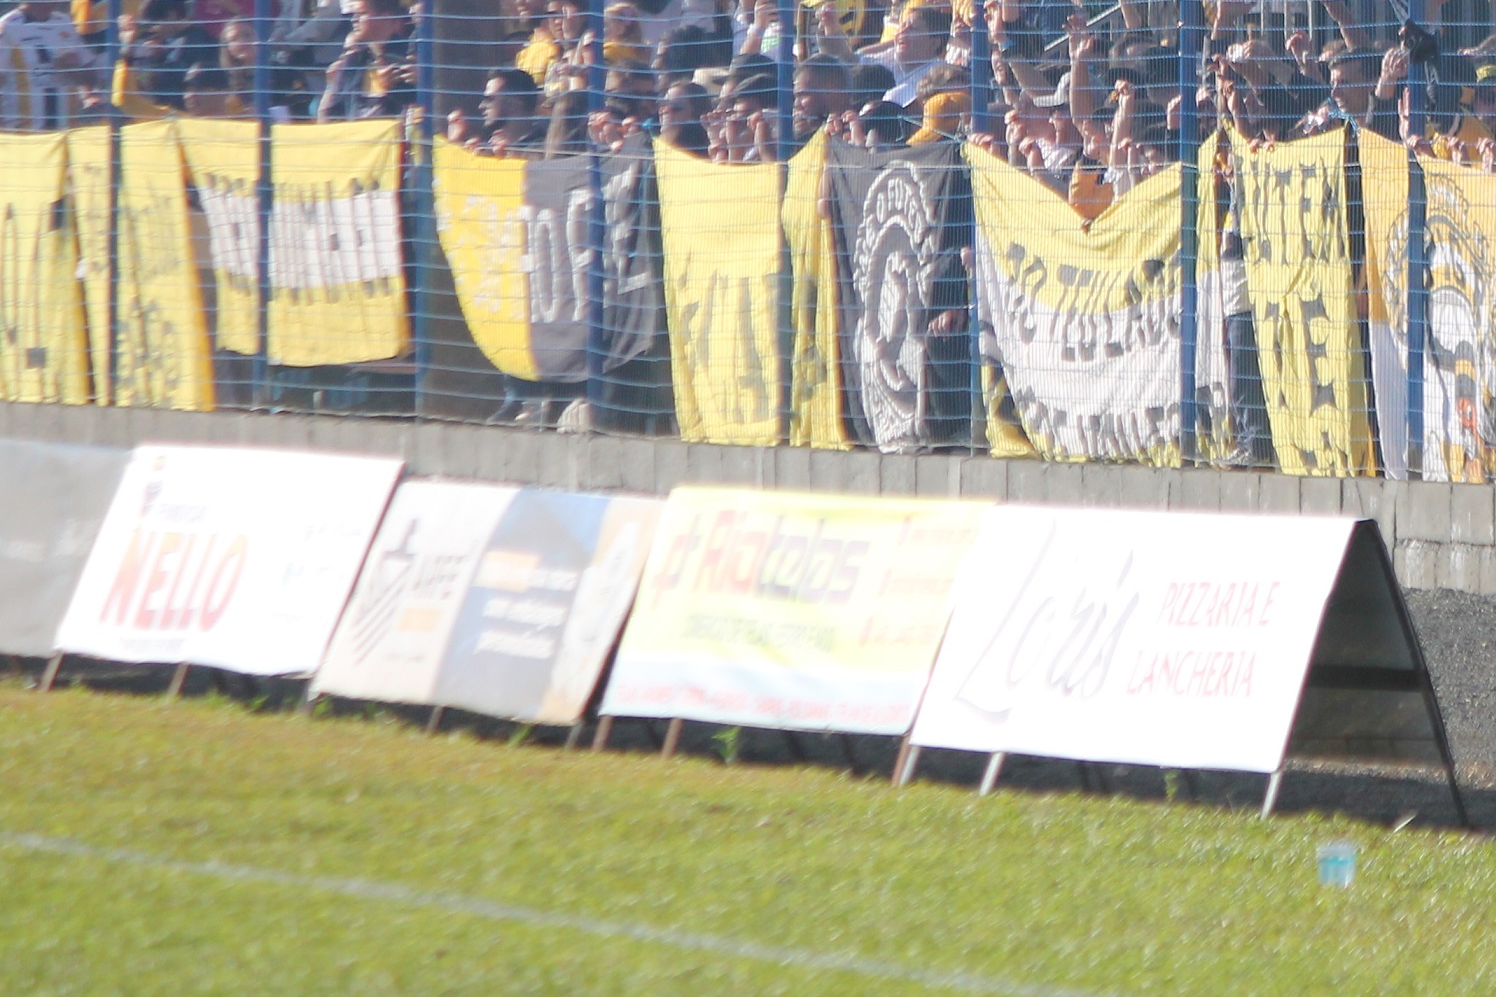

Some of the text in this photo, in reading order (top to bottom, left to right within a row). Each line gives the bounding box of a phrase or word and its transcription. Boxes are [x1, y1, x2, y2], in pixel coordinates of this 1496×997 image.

[98, 526, 250, 633] NELLO
[1155, 580, 1281, 629] PIZZARIA E
[1125, 650, 1258, 698] LANCHERIA
